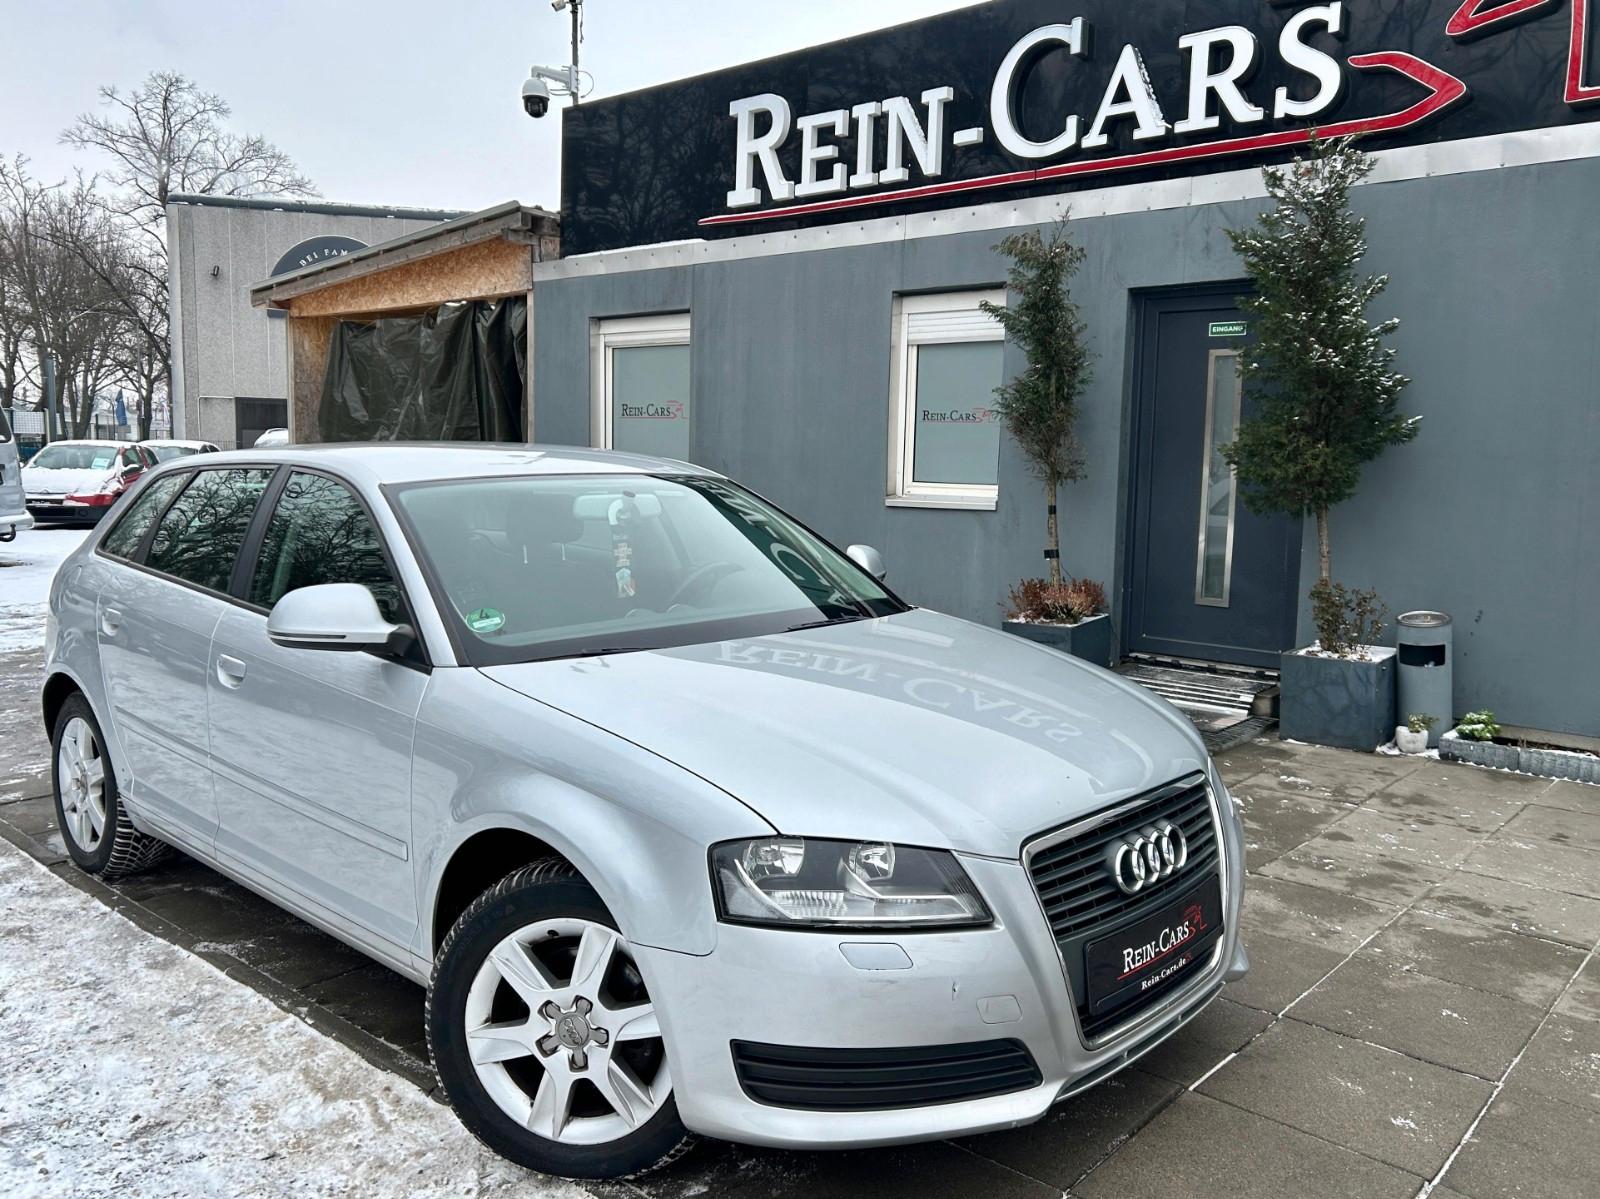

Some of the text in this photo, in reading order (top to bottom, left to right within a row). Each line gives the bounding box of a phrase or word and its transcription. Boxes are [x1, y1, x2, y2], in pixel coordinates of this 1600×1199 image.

[727, 1, 1345, 208] REIN-CARS
[299, 251, 319, 267] BEI
[621, 403, 671, 417] REIN-CARS
[922, 409, 977, 421] REIN-CARS
[1122, 920, 1190, 973] REIN-CARS
[1141, 957, 1187, 991] Rein-Cars.de
